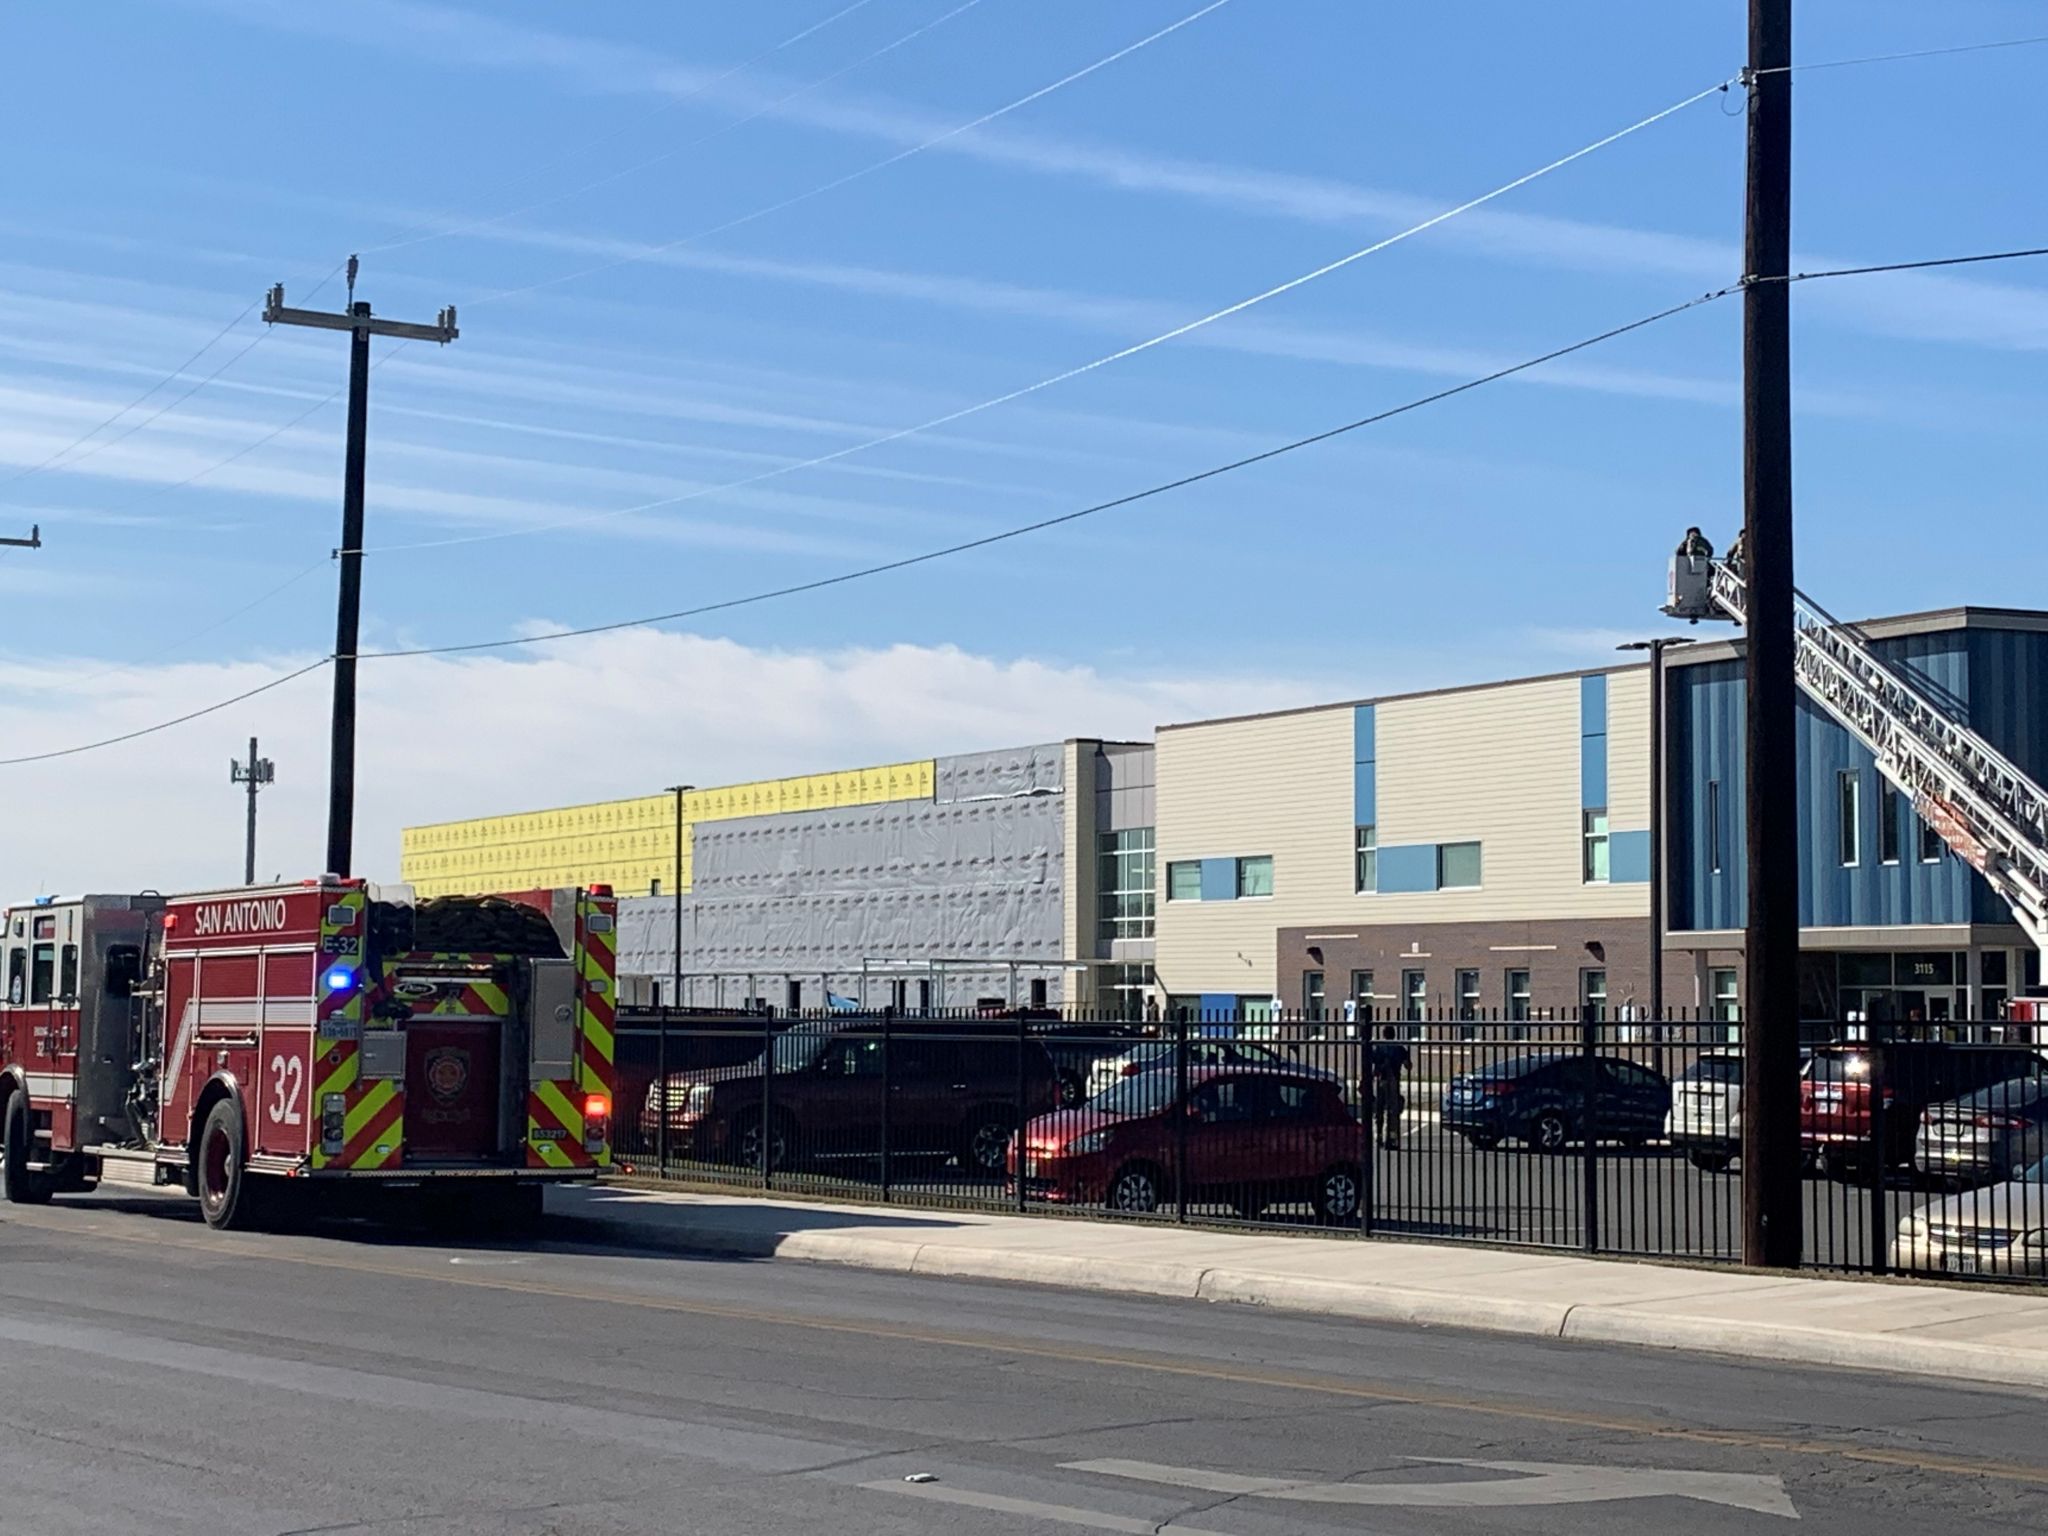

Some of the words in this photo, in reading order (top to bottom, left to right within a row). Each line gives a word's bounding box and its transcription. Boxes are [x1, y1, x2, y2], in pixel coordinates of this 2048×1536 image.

[195, 904, 221, 935] SAN
[223, 898, 286, 933] ANTONIO
[323, 936, 358, 953] E-32
[1914, 963, 1935, 975] 3115
[269, 1054, 302, 1125] 32
